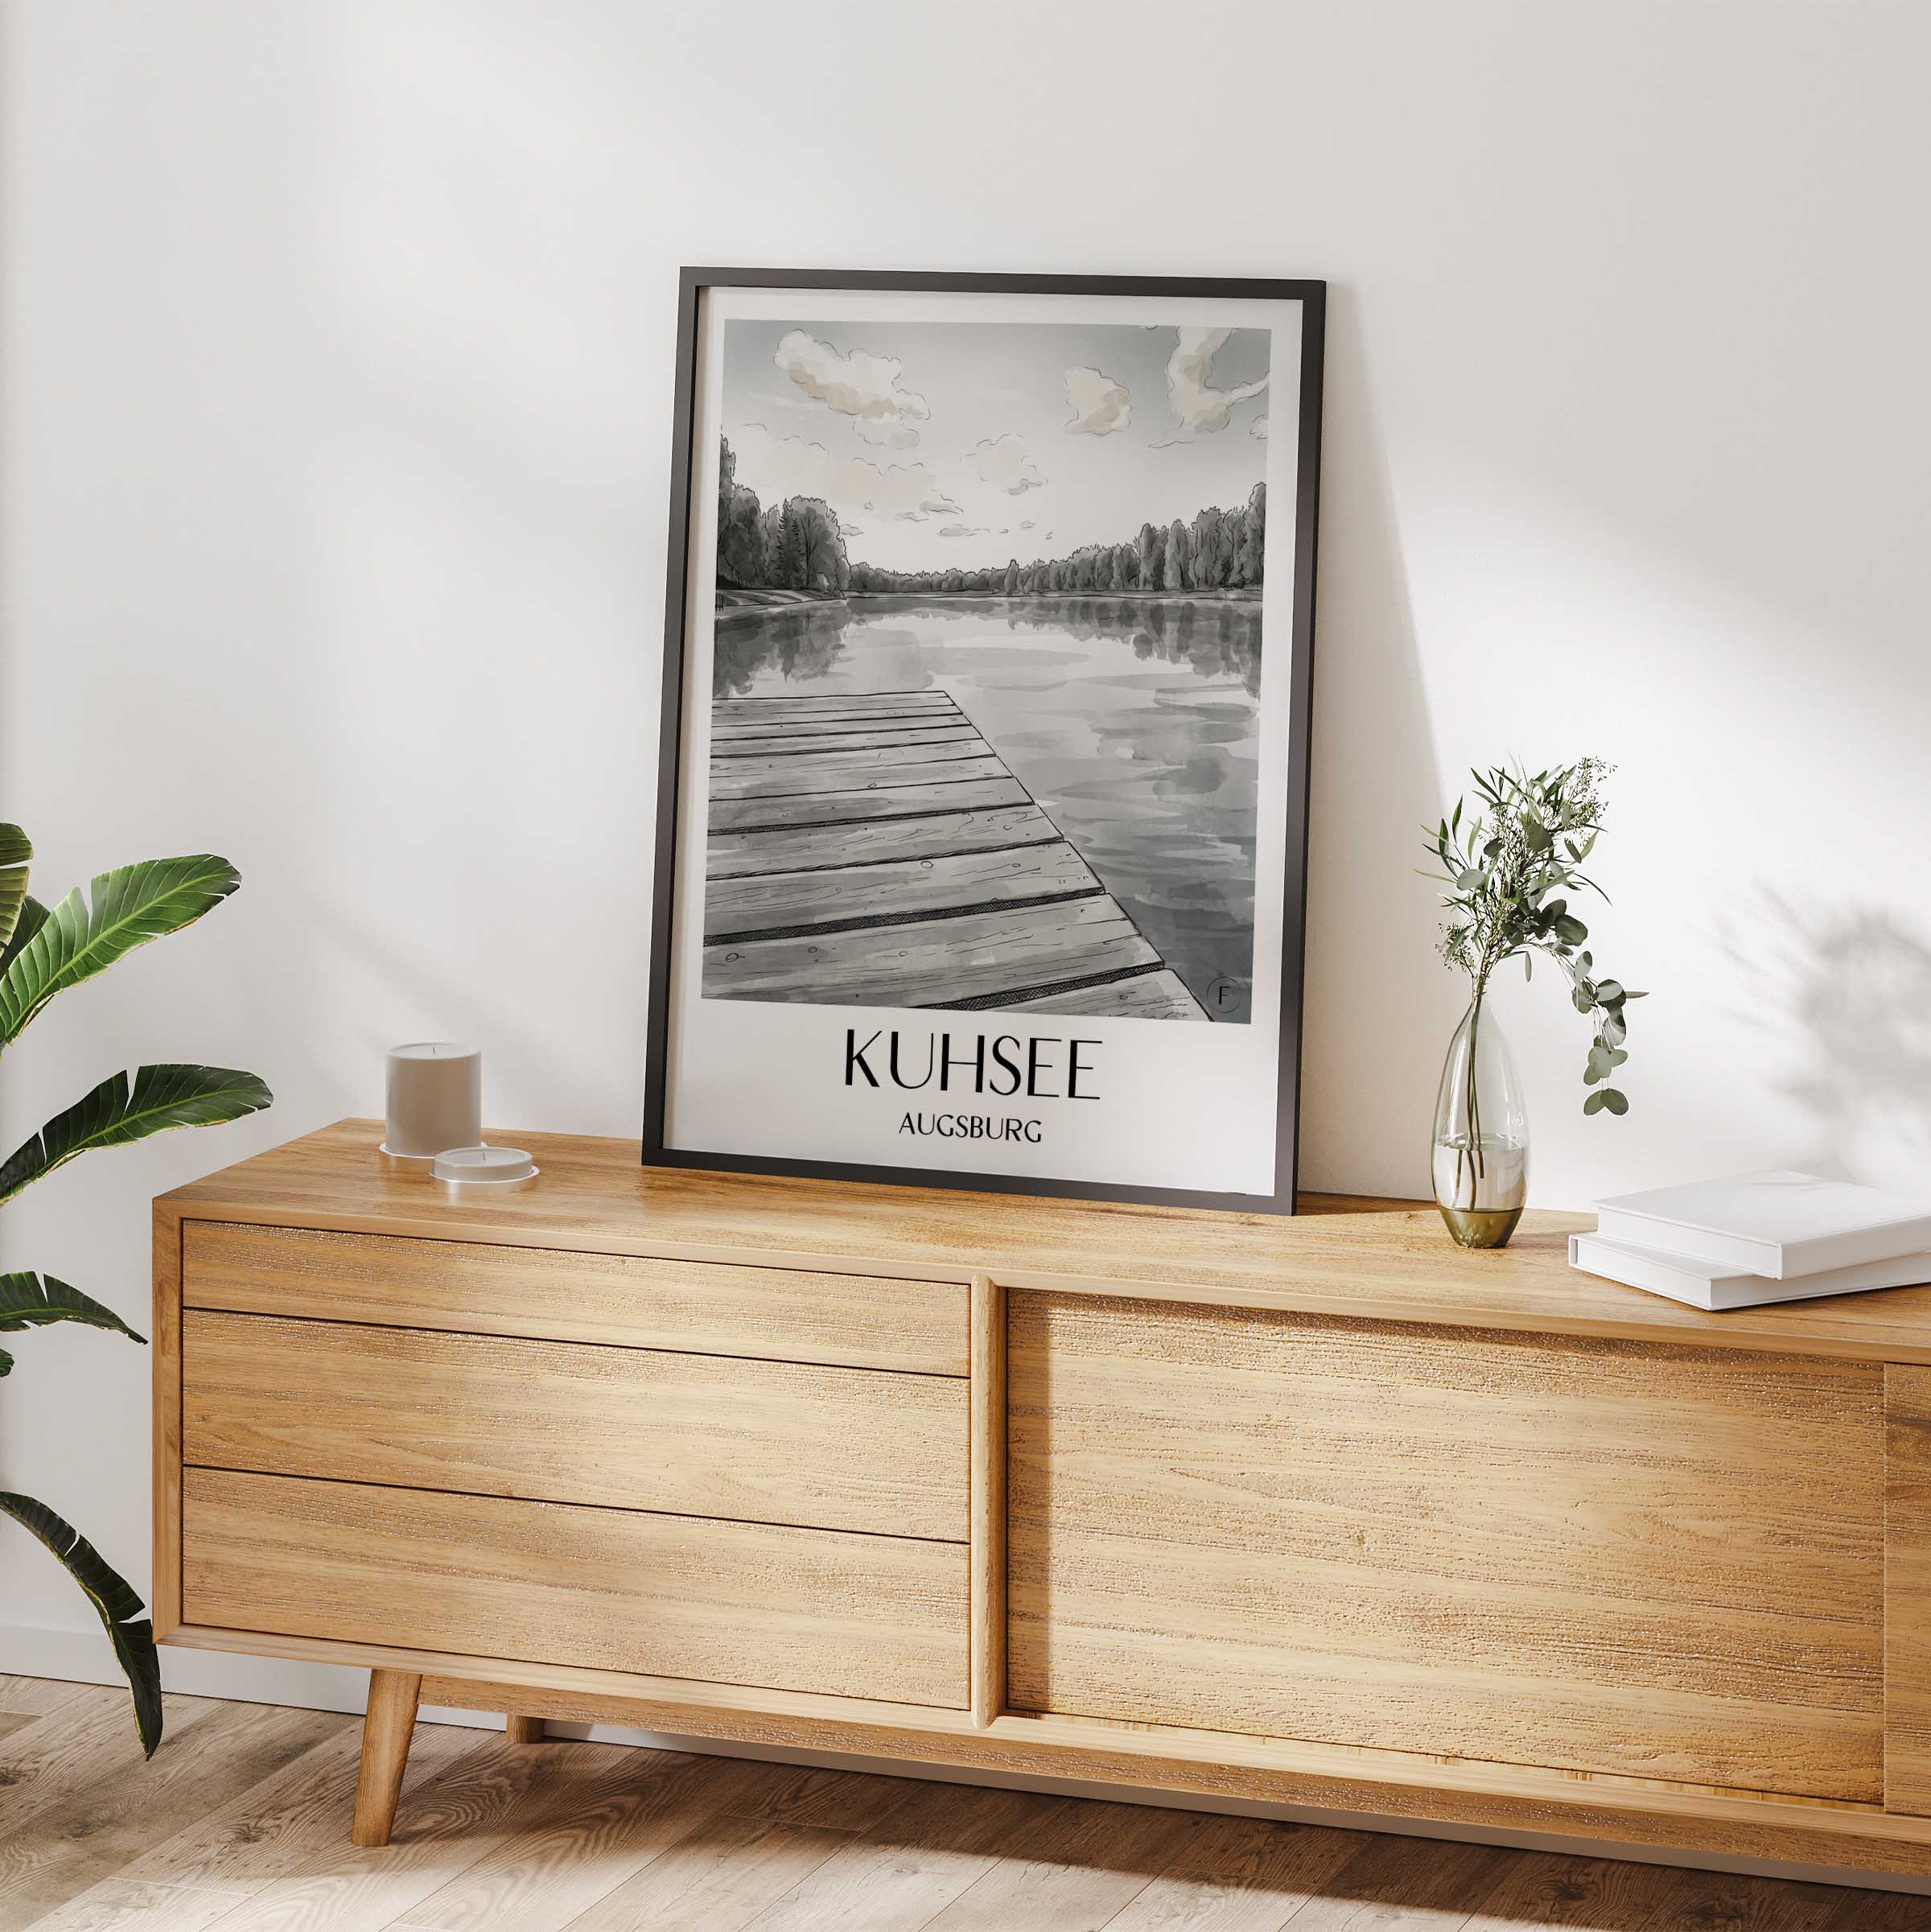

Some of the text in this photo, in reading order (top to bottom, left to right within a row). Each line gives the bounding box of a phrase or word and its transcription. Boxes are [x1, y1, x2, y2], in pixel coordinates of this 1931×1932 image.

[1218, 986, 1230, 1005] F
[845, 1028, 1103, 1100] KUHSEE
[898, 1111, 1042, 1143] AUGSBURG
